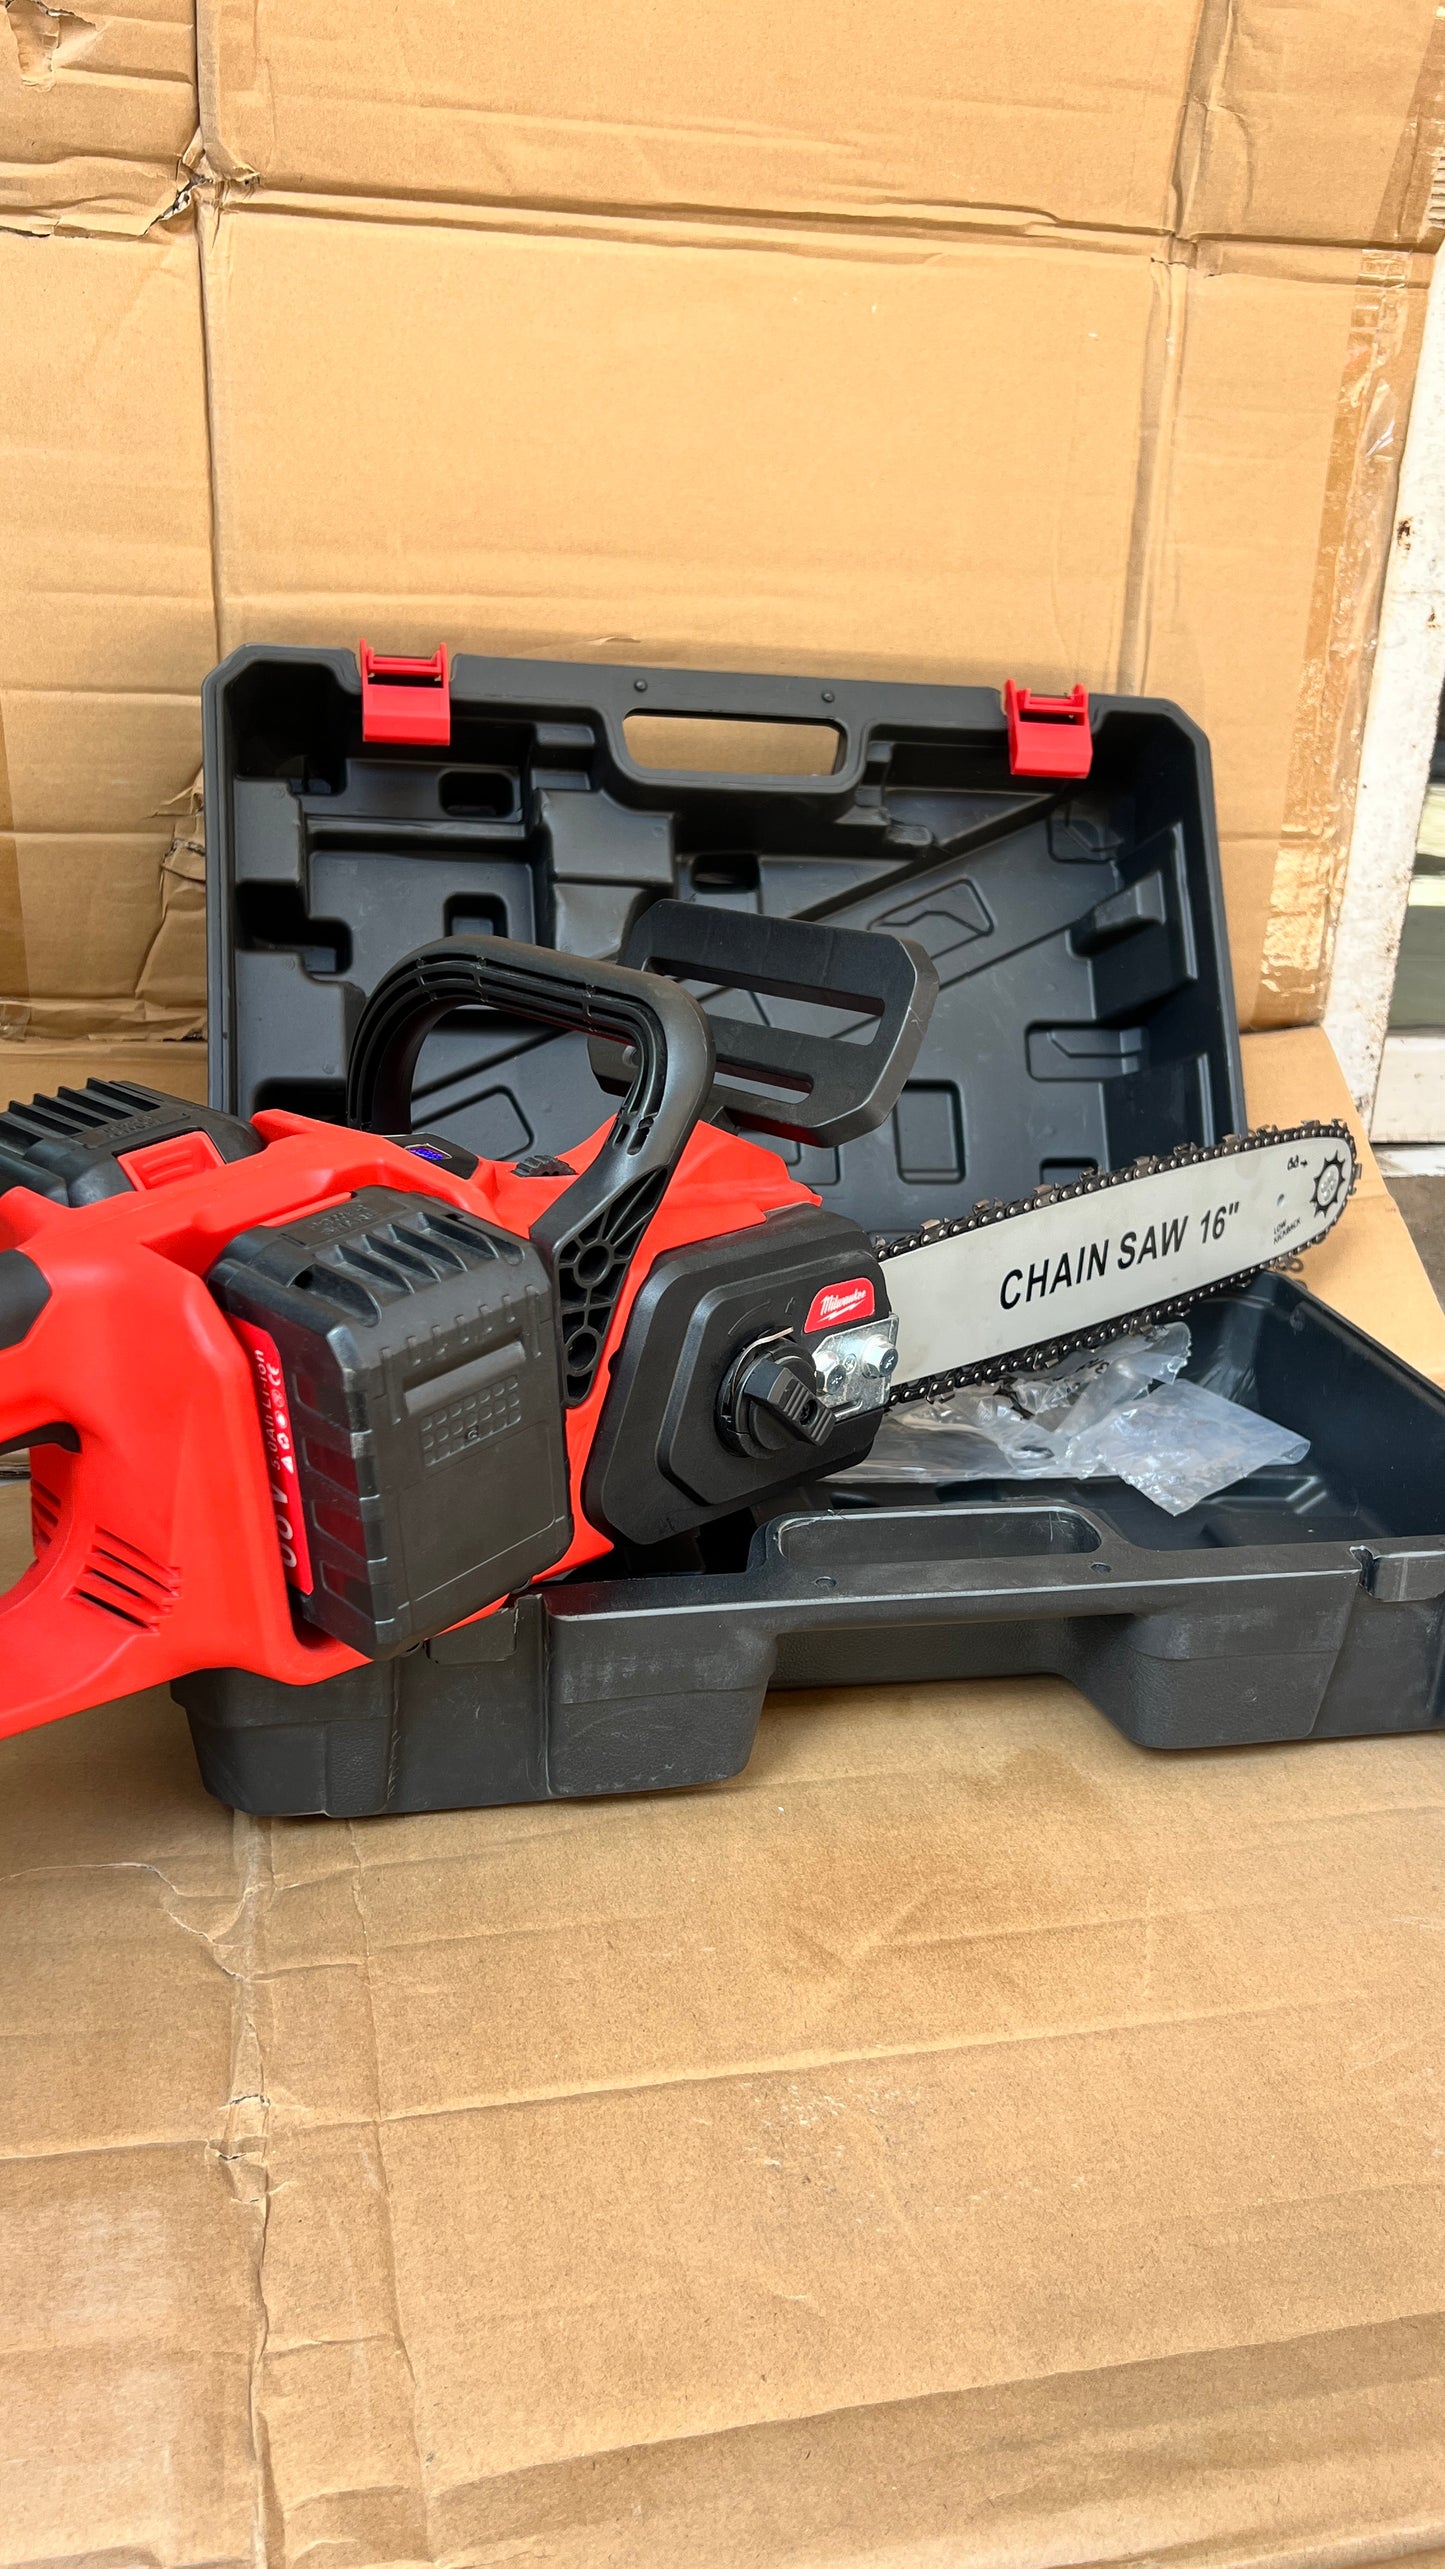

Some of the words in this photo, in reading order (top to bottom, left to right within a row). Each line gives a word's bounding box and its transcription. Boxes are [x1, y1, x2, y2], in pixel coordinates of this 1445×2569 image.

[1273, 1219, 1287, 1235] LOW
[1273, 1217, 1302, 1245] KICKBACK
[999, 1238, 1110, 1310] CHAIN
[1117, 1215, 1189, 1270] SAW
[1200, 1201, 1241, 1244] 16"
[820, 1287, 867, 1316] Milwaukee
